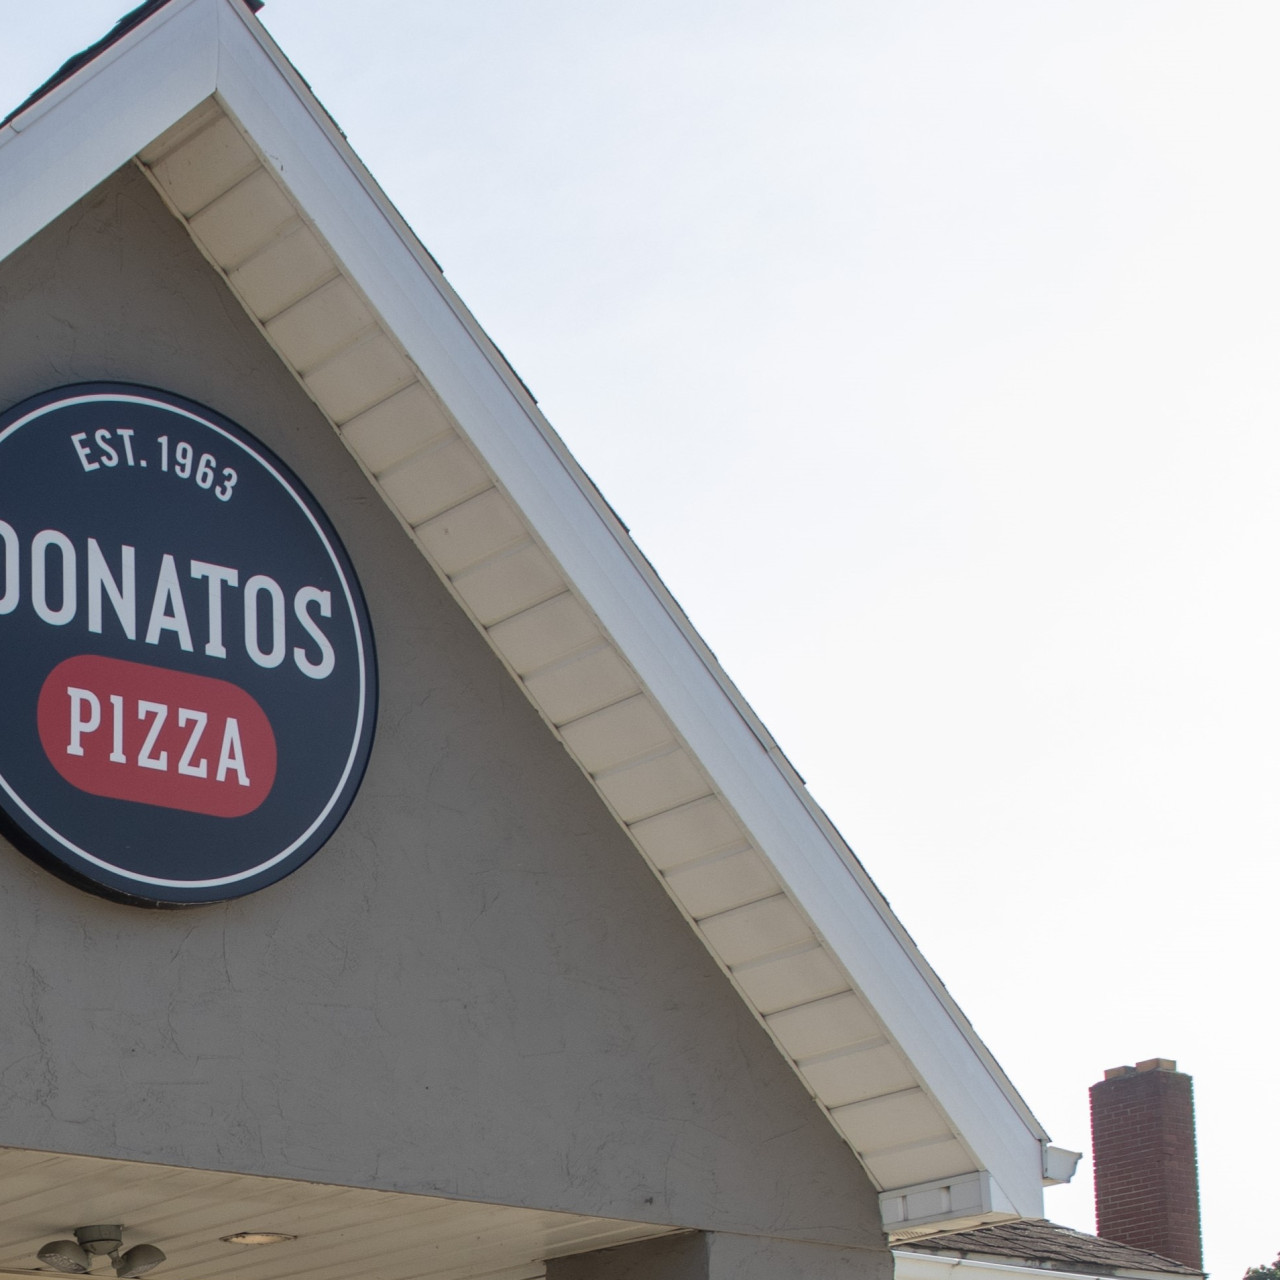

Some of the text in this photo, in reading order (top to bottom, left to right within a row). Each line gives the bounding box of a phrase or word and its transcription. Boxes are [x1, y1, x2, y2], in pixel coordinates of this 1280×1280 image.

[70, 428, 239, 502] EST. 1963
[66, 686, 252, 788] PIZZA
